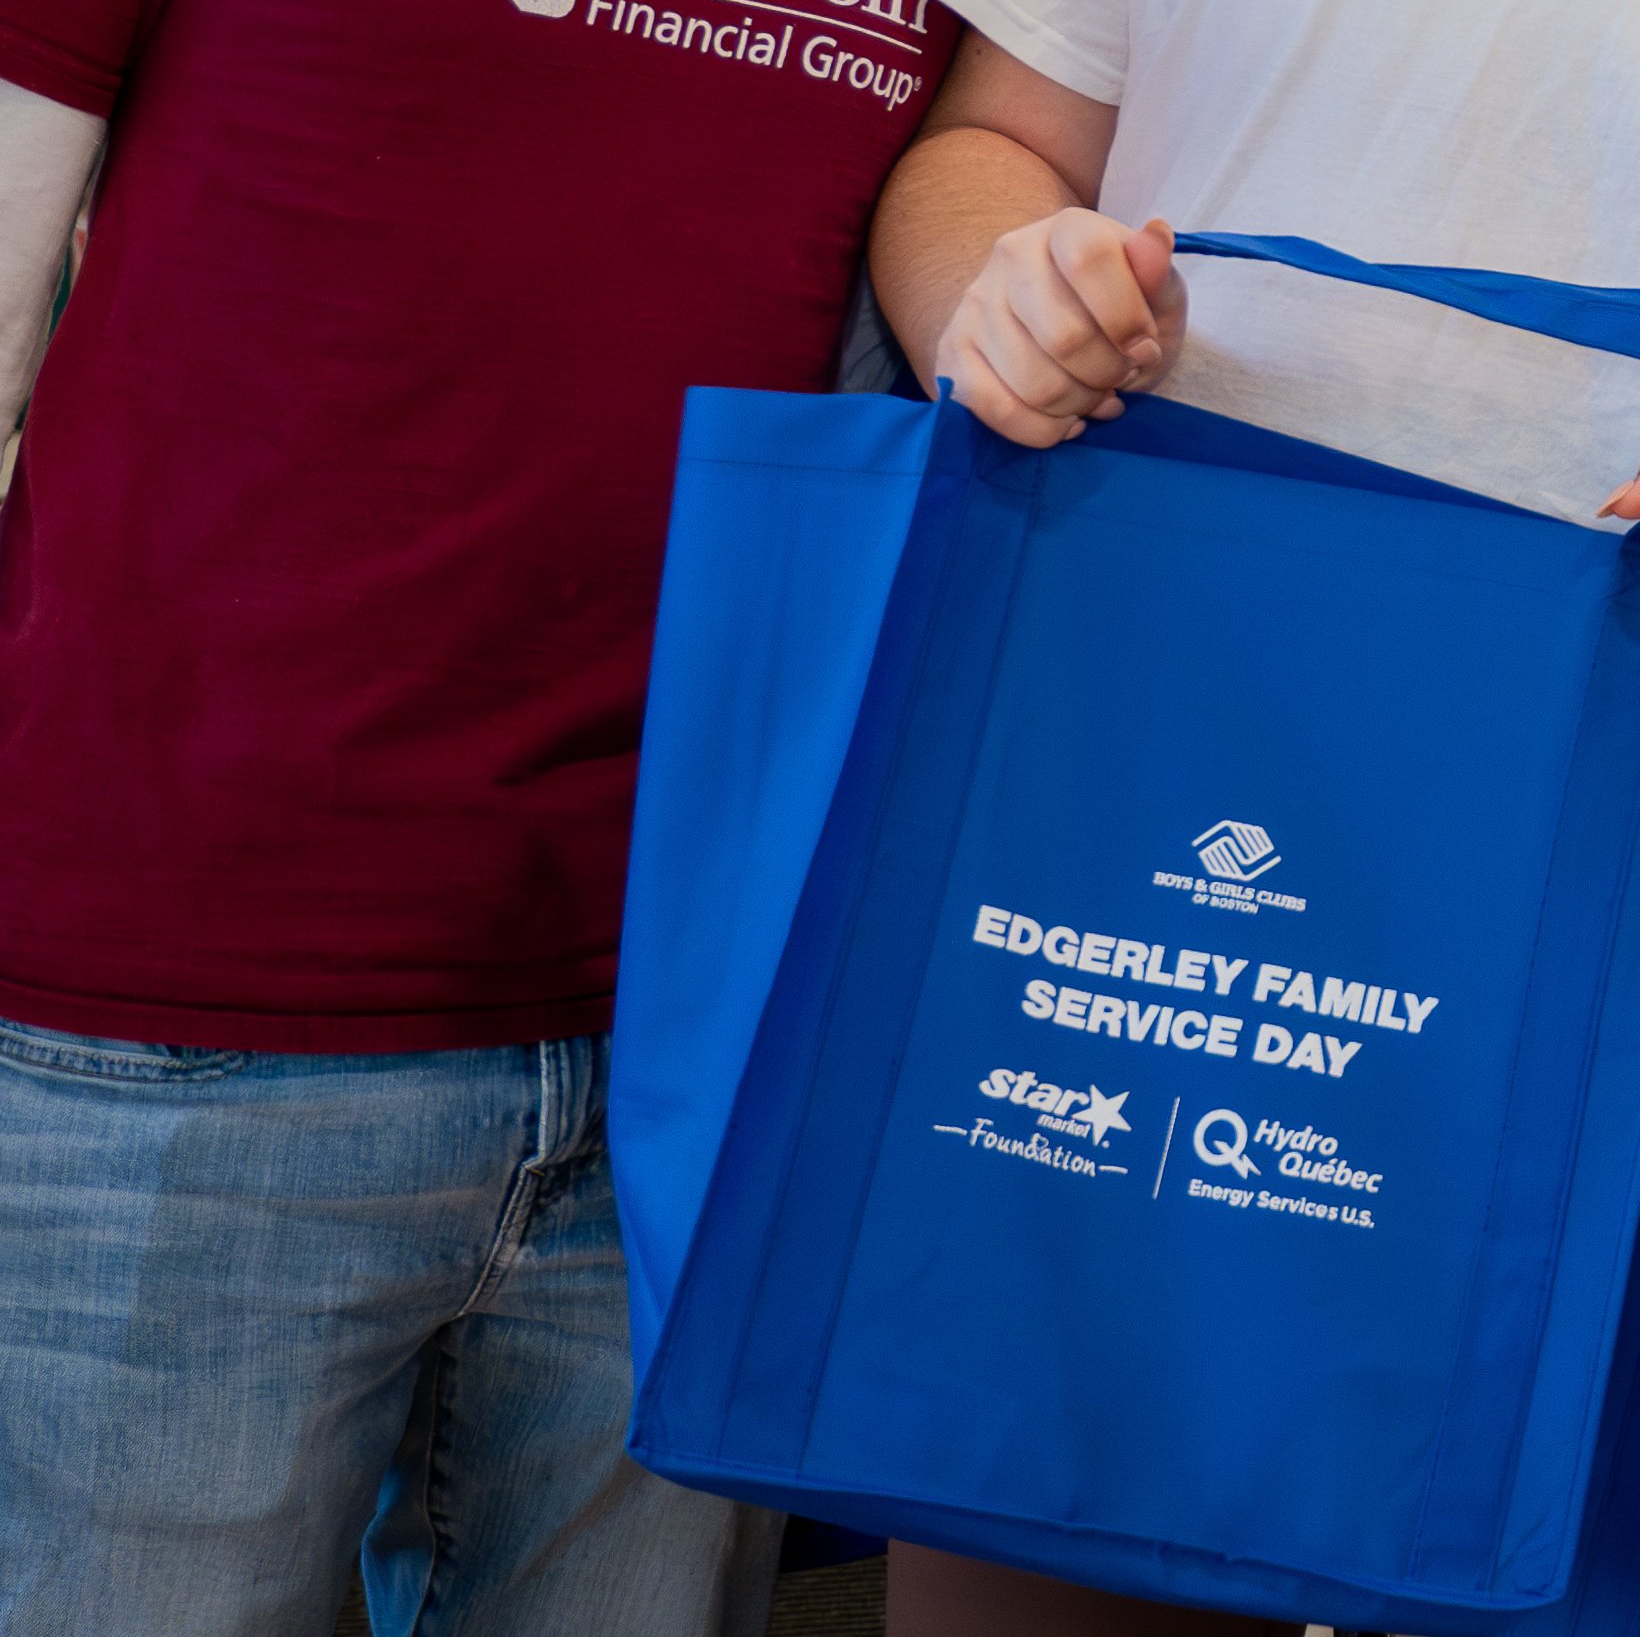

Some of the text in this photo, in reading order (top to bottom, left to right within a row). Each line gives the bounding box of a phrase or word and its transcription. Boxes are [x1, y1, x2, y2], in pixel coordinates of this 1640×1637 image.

[1152, 871, 1307, 913] BOYS & GIRLS CLUBS
[1191, 893, 1260, 916] OF BOSTON
[972, 904, 1439, 1035] EDGERLEY FAMILY
[1021, 979, 1363, 1079] SERVICE DAY
[1253, 1118, 1339, 1156] Hydro
[1278, 1151, 1384, 1194] Québec
[1187, 1177, 1376, 1229] Energy Services U.S.
